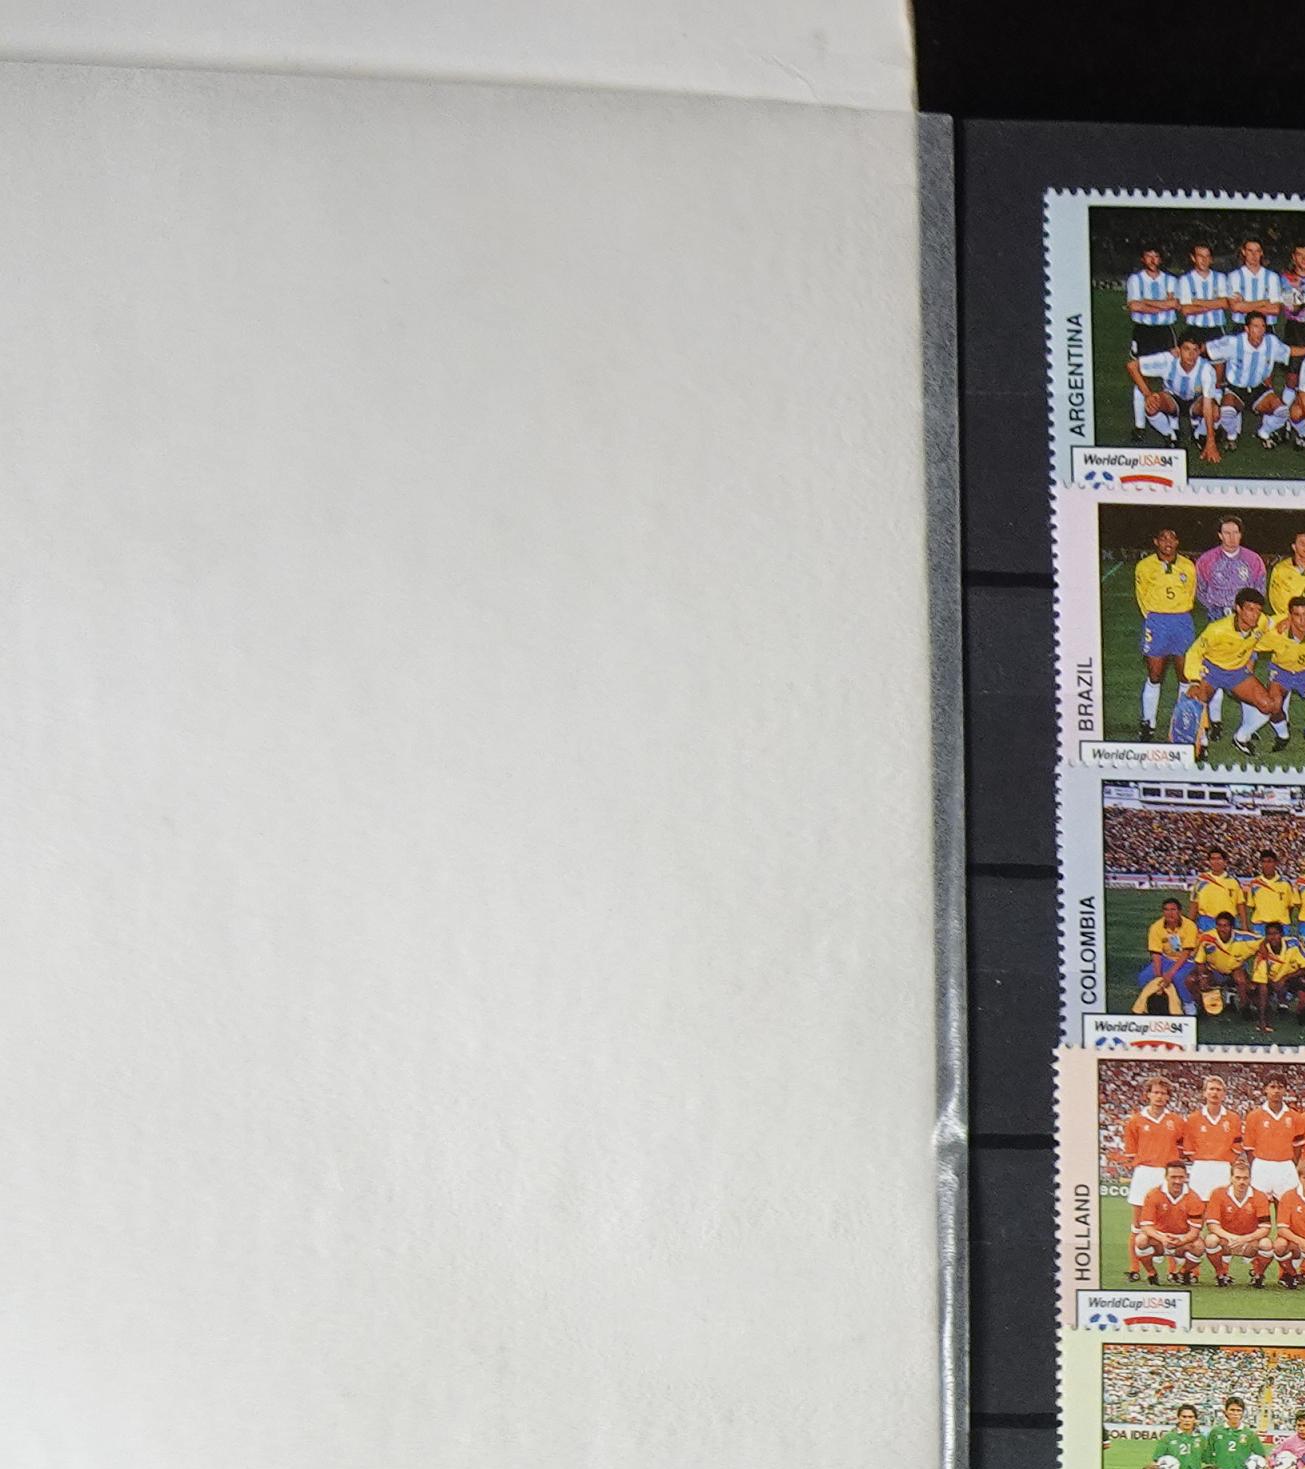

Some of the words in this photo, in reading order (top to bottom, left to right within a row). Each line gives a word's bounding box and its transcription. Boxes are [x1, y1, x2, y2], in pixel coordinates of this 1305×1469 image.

[1066, 313, 1086, 438] ARGENTINA
[1166, 587, 1176, 600] 5
[1076, 657, 1094, 732] BRAZIL
[1079, 896, 1097, 1005] COLOMBIA
[1074, 1183, 1091, 1281] HOLLAND
[1228, 1441, 1236, 1451] 2
